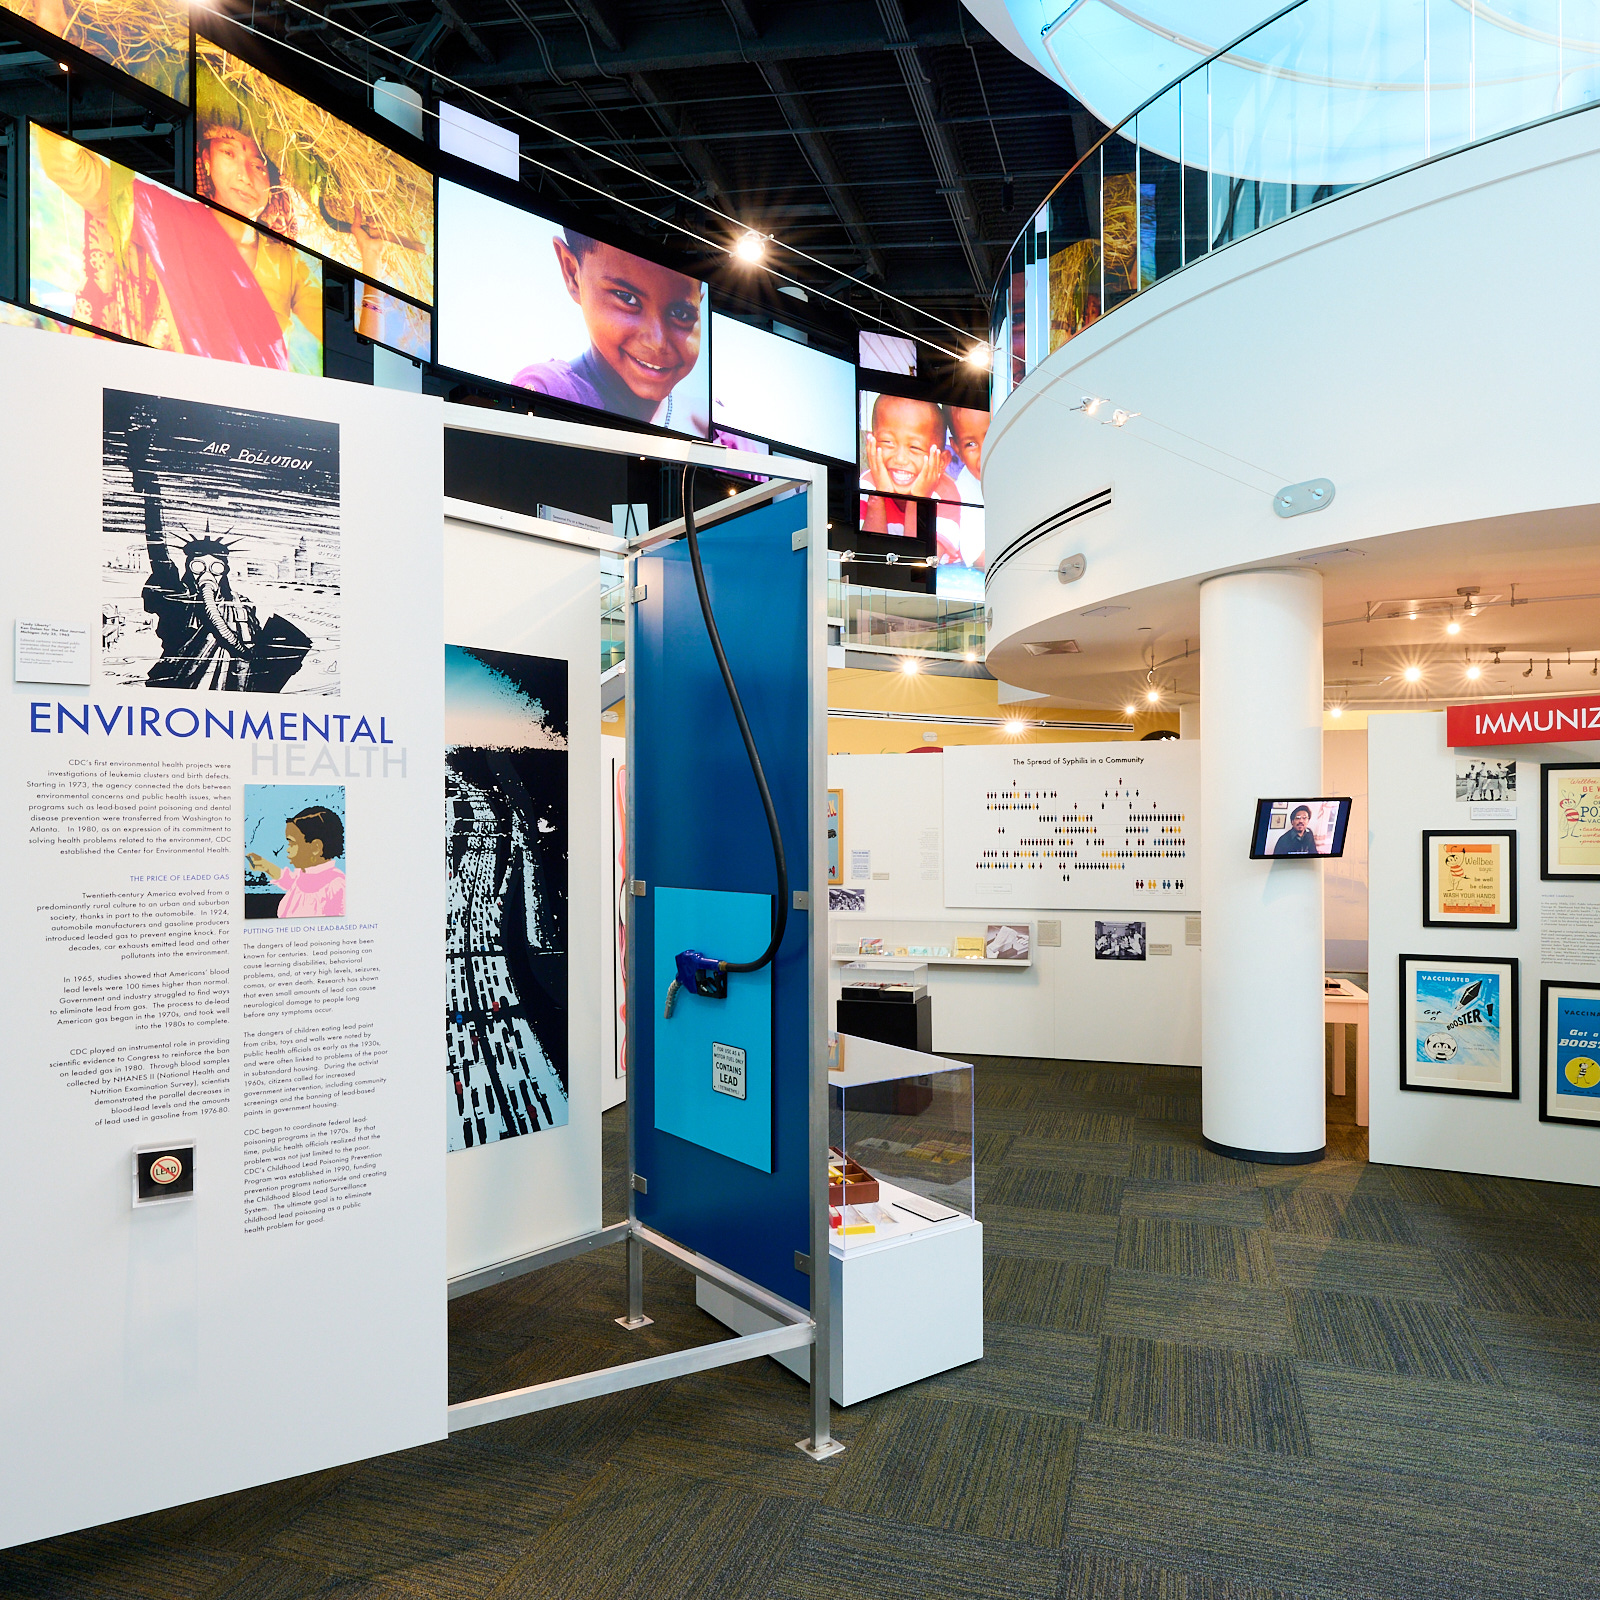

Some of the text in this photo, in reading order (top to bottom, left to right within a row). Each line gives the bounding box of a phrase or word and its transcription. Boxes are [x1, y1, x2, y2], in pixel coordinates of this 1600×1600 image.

[202, 442, 312, 470] AIR POLLUTION
[30, 702, 394, 744] ENVIRONMENTAL
[1476, 707, 1600, 734] IMMUNIZ
[185, 761, 212, 769] projects
[252, 742, 408, 778] HEALTH
[1026, 757, 1051, 767] Spread
[1061, 756, 1088, 766] Syphilis
[1105, 755, 1144, 764] Community
[47, 769, 97, 779] investigations
[26, 780, 56, 789] Starting
[66, 779, 89, 789] 1973,
[36, 791, 89, 801] environmental
[141, 792, 164, 801] public
[28, 802, 64, 811] programs
[138, 804, 156, 812] paint
[158, 804, 192, 812] poisoning
[60, 814, 100, 823] prevention
[122, 814, 161, 822] transferred
[181, 814, 222, 823] Washington
[123, 825, 161, 833] expression
[28, 836, 55, 845] solving
[82, 836, 116, 844] problems
[118, 836, 144, 846] related
[1465, 857, 1494, 865] Wellbee
[1446, 1009, 1482, 1030] BOOSTER
[716, 1061, 742, 1076] CONTAINS
[720, 1072, 738, 1086] LEAD
[156, 1166, 177, 1175] LEAD
